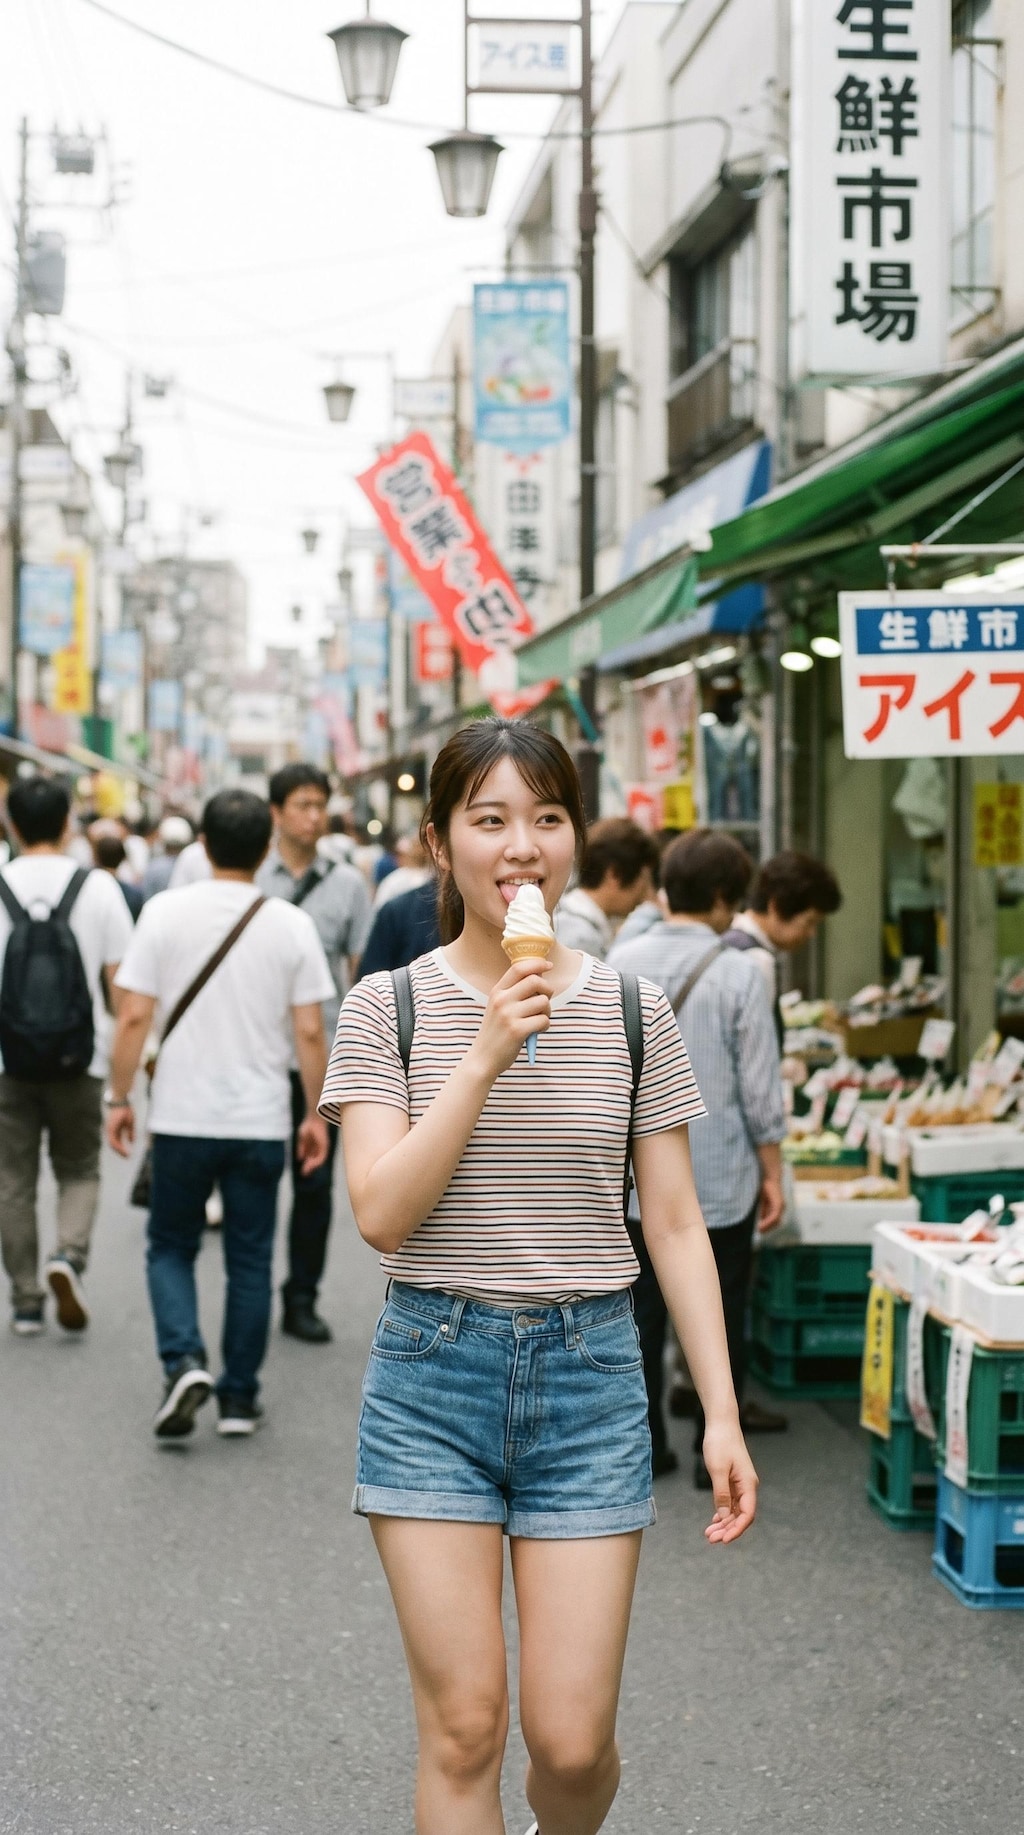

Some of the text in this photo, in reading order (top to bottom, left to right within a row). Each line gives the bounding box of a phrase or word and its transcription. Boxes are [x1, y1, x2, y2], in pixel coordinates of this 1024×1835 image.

[834, 0, 919, 342] 生鮮市場
[878, 608, 1019, 650] 生鮮市
[859, 669, 1024, 743] アイス
